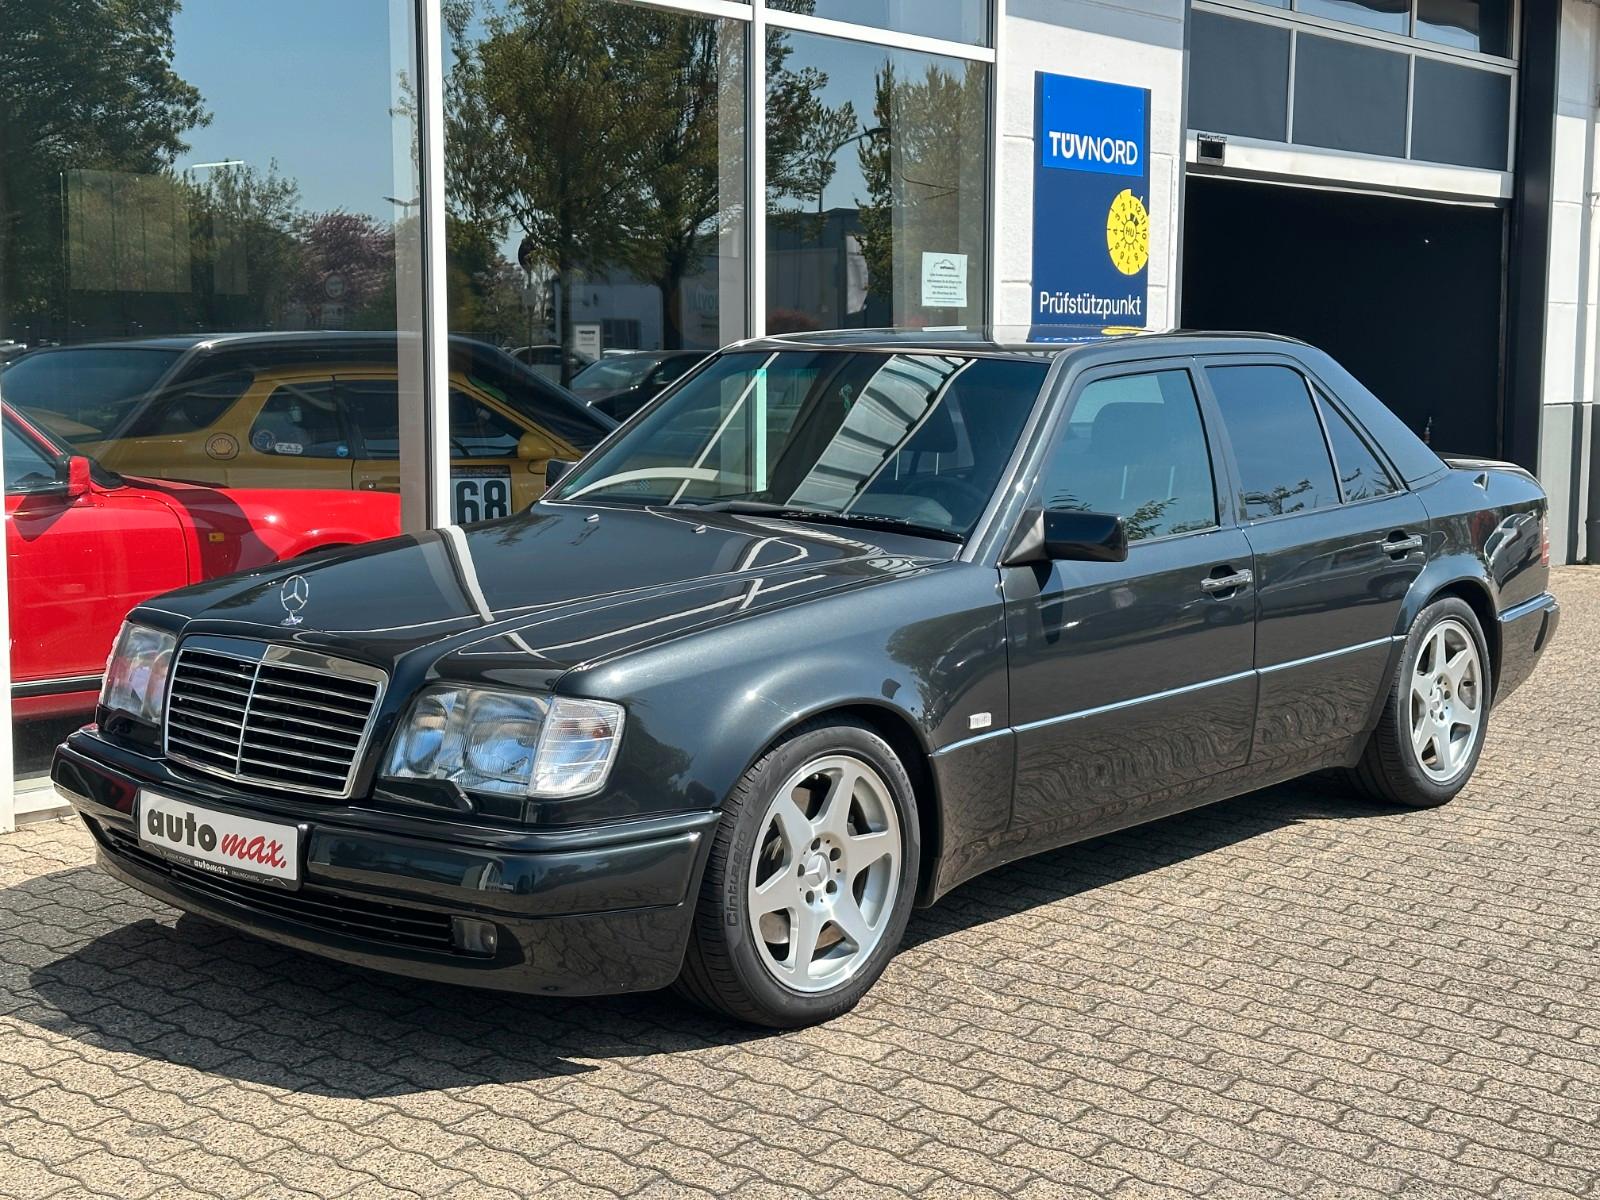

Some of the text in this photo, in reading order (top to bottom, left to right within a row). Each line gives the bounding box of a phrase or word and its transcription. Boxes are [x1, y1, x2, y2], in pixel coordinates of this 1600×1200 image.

[1125, 226, 1135, 238] HU
[1039, 291, 1142, 320] Prüfstützpunkt
[456, 480, 508, 525] 68
[147, 808, 218, 852] auto
